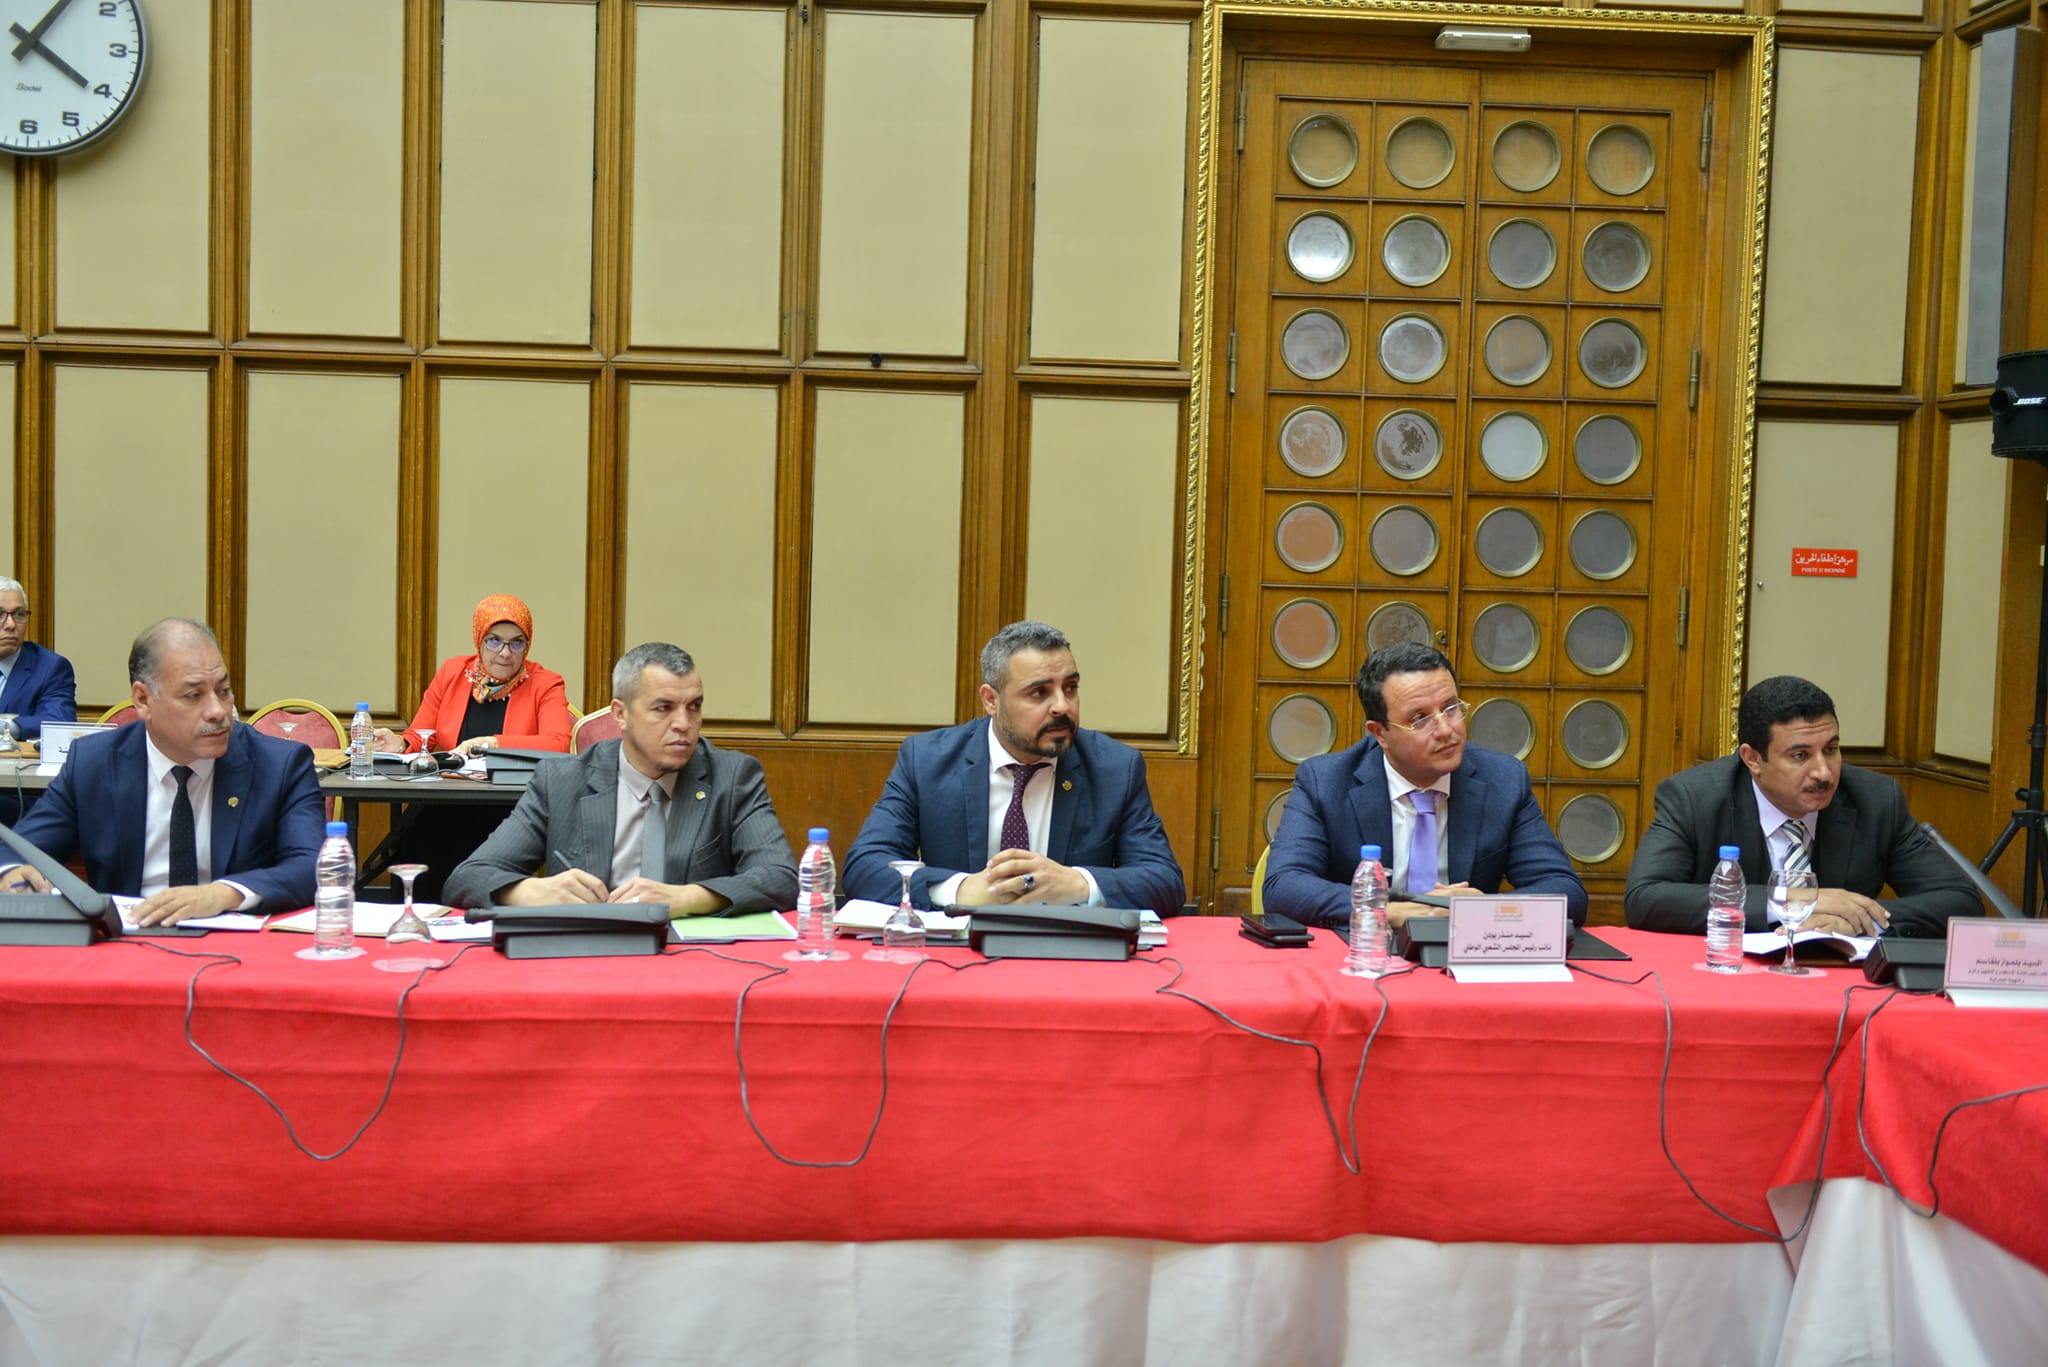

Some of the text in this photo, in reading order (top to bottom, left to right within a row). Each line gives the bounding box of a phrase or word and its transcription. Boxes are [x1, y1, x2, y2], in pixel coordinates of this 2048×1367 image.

[99, 2, 117, 17] 2
[109, 43, 127, 58] 3
[93, 84, 112, 98] 4
[19, 119, 38, 134] 6
[62, 111, 80, 127] 5
[1795, 552, 1817, 565] الحريق
[1837, 555, 1854, 566] مركز
